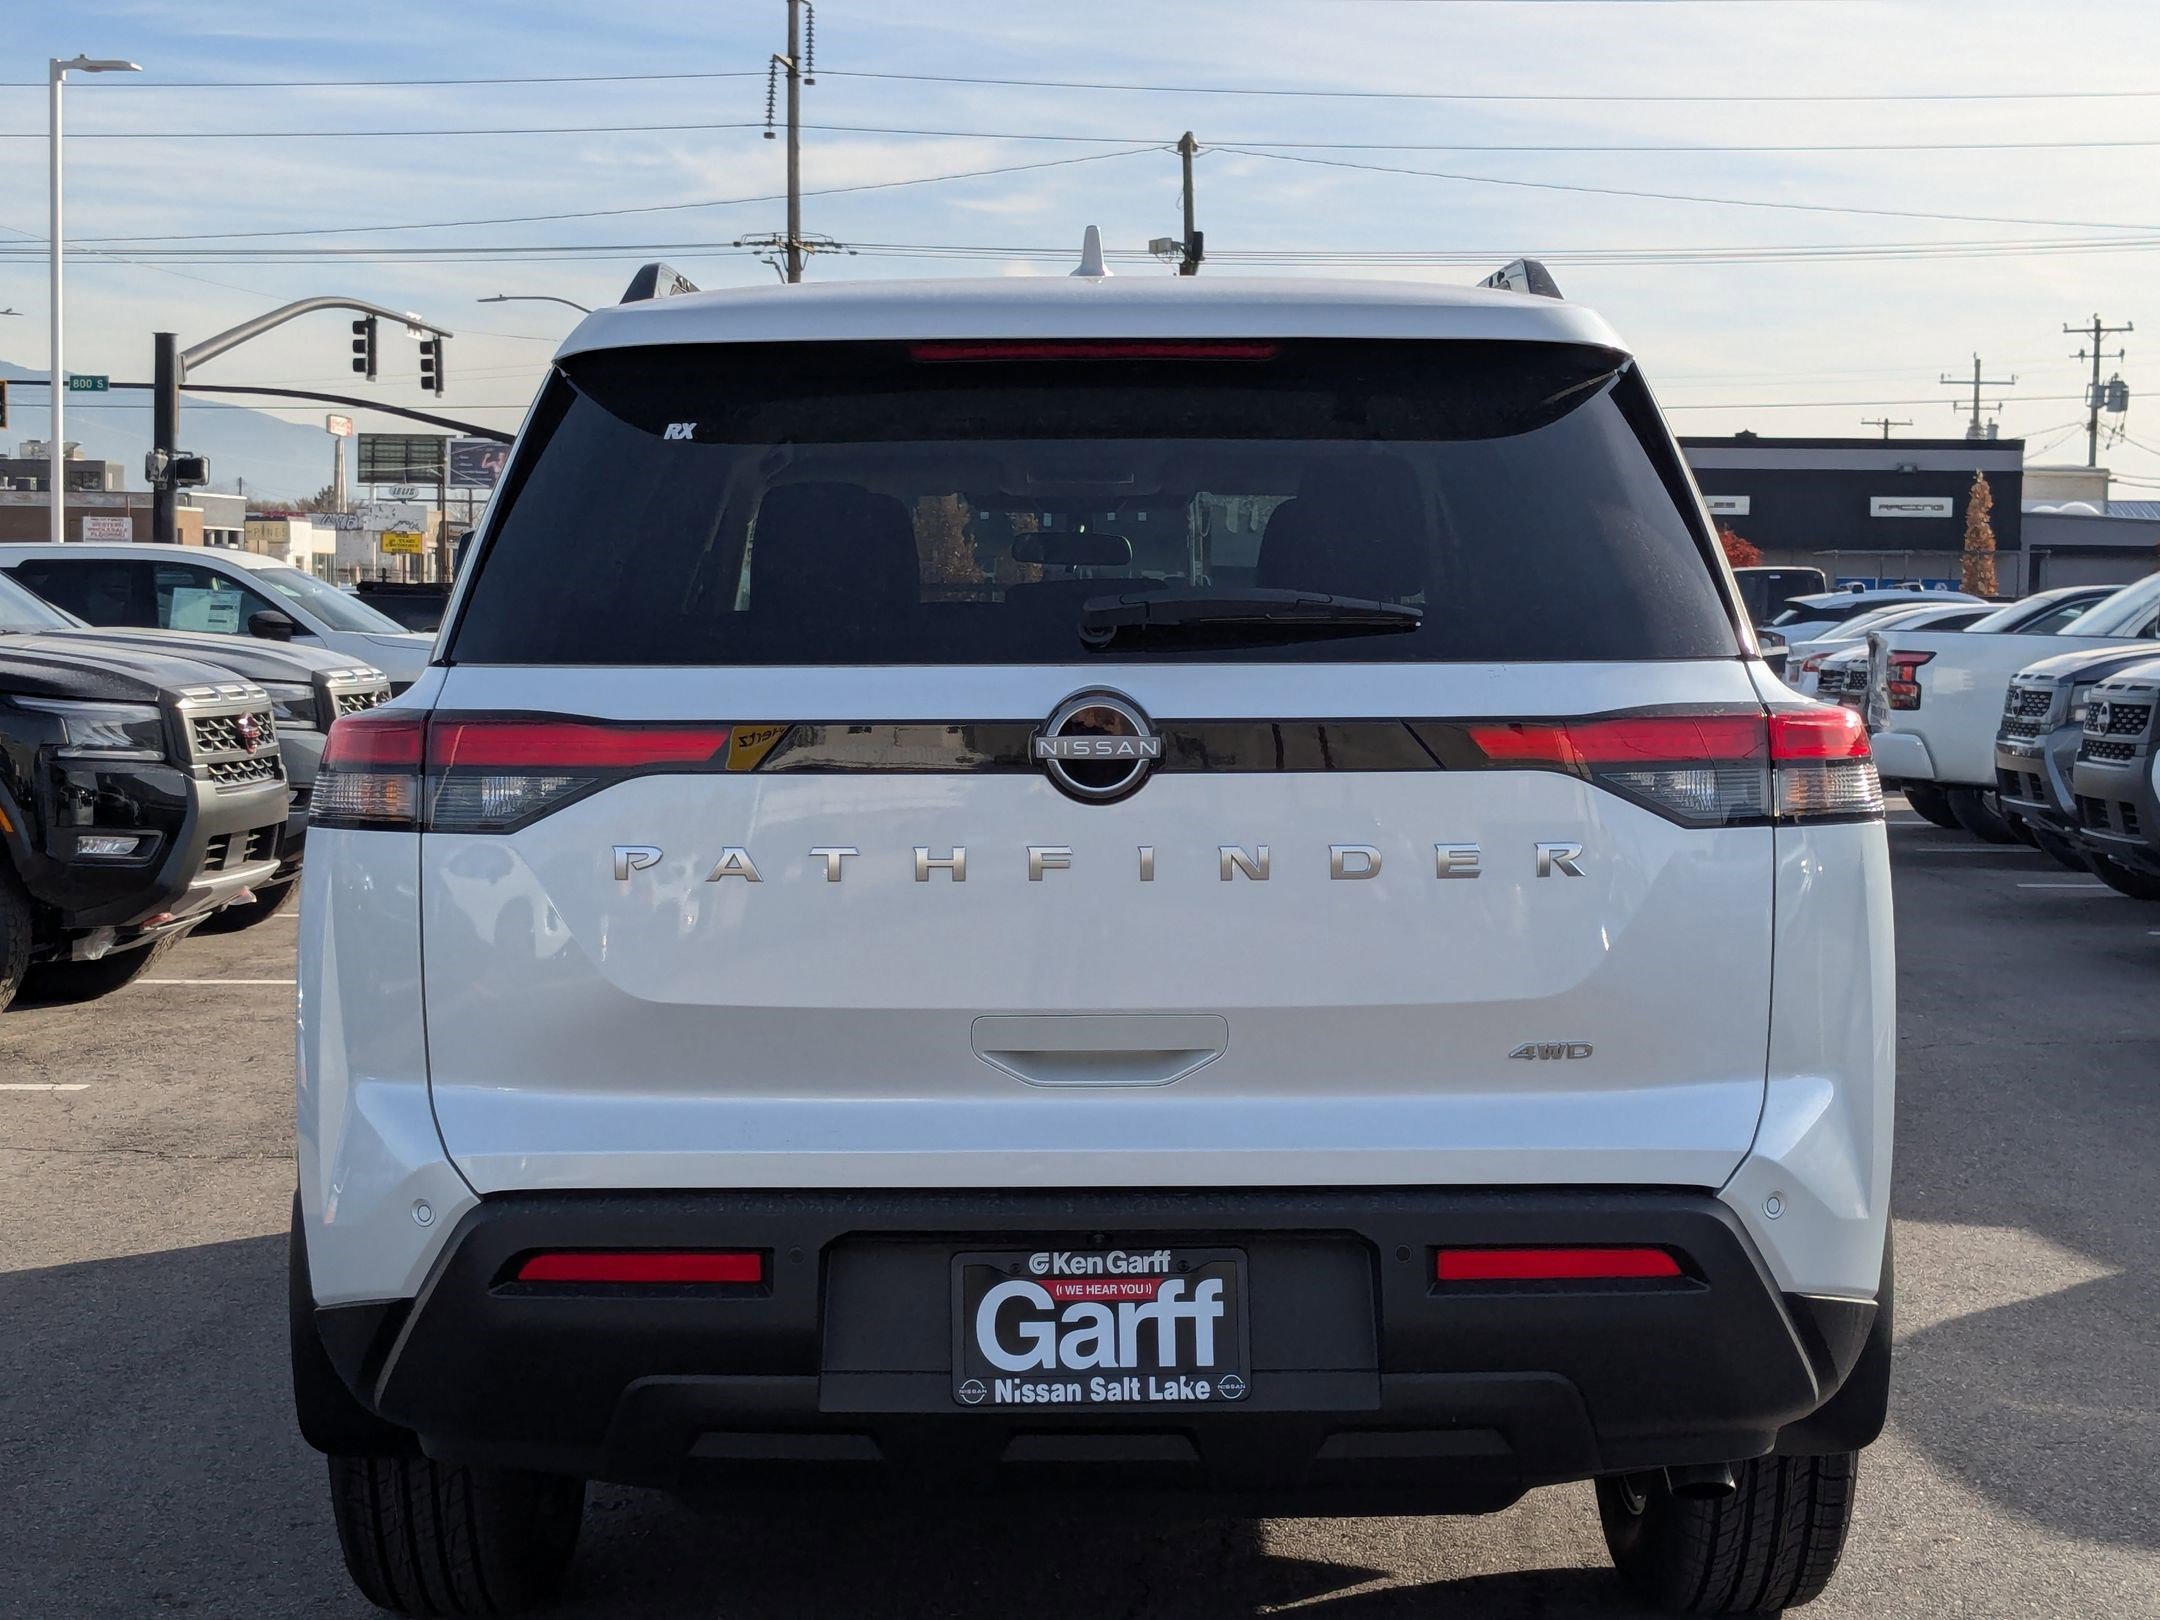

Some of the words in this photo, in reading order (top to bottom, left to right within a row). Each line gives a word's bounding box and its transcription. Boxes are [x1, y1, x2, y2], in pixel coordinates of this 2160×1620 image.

[73, 379, 92, 388] 800
[97, 380, 103, 388] S
[664, 422, 697, 439] RX
[1039, 740, 1159, 756] NISSAN
[612, 842, 1587, 883] PATHFINDER
[1508, 1040, 1593, 1060] 4WD
[1052, 1251, 1102, 1275] Ken
[1106, 1250, 1171, 1274] Garff
[1064, 1284, 1084, 1295] WE
[1086, 1284, 1118, 1295] HEAR
[1119, 1284, 1144, 1295] YOU
[975, 1278, 1225, 1372] Garff
[995, 1378, 1082, 1403] Nissan
[1090, 1377, 1141, 1402] Salt
[1149, 1376, 1211, 1401] Lake
